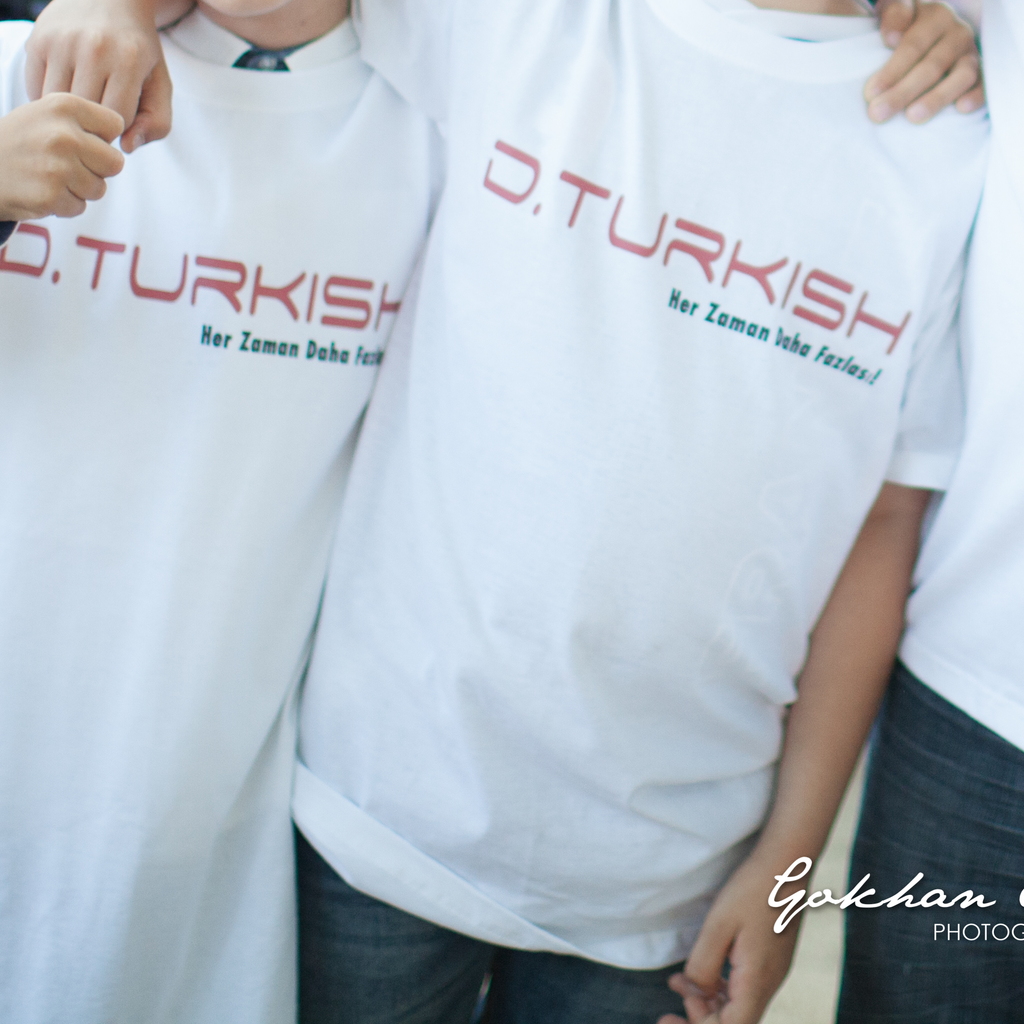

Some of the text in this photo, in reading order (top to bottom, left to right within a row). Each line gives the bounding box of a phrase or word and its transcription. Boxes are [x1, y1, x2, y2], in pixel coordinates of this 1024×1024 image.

[483, 139, 912, 355] D.TURKISH
[200, 325, 232, 350] Her
[239, 331, 299, 358] Zaman
[306, 340, 349, 364] Daha
[668, 288, 699, 318] Her
[704, 302, 770, 342] Zaman
[775, 326, 812, 357] Daha
